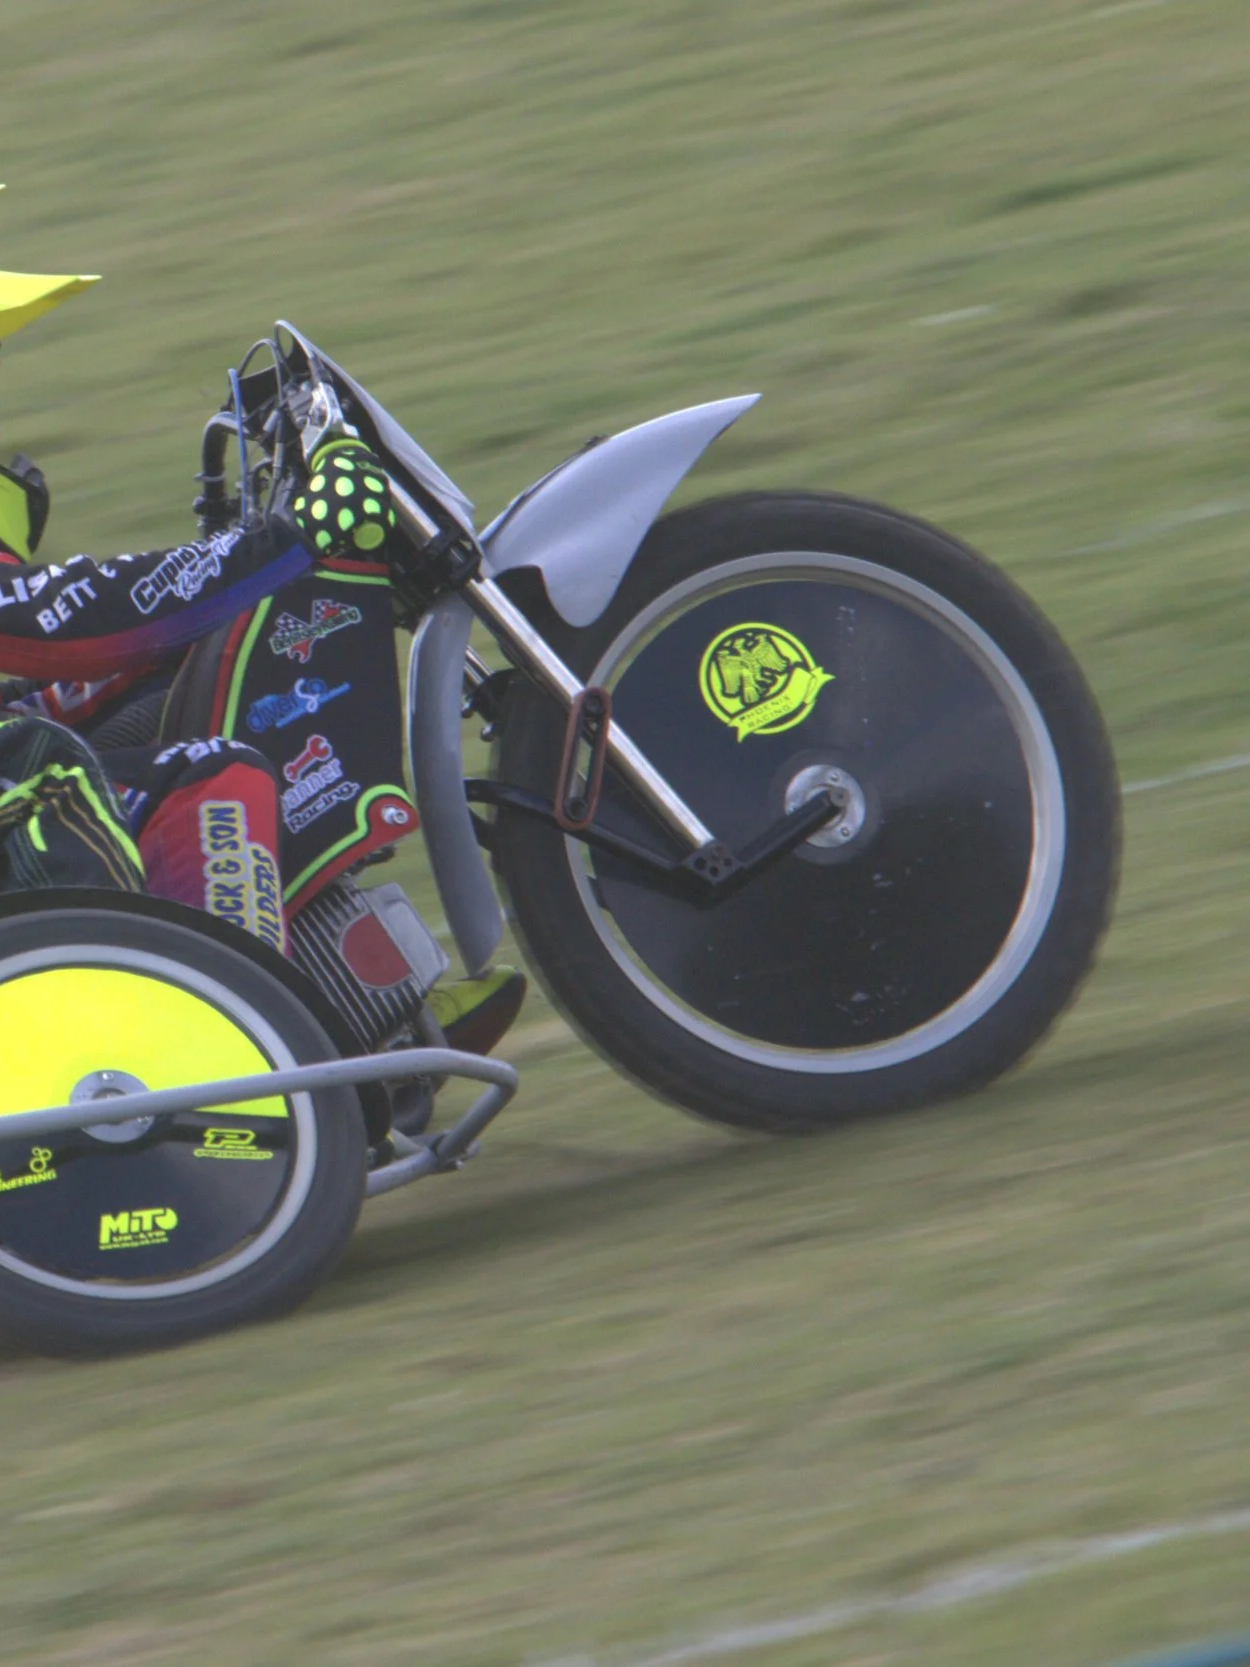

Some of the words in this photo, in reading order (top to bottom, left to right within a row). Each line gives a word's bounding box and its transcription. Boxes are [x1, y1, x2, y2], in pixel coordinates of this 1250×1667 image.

[36, 577, 97, 634] BETT
[748, 703, 792, 727] RACING
[207, 806, 240, 852] SON
[211, 859, 241, 875] &
